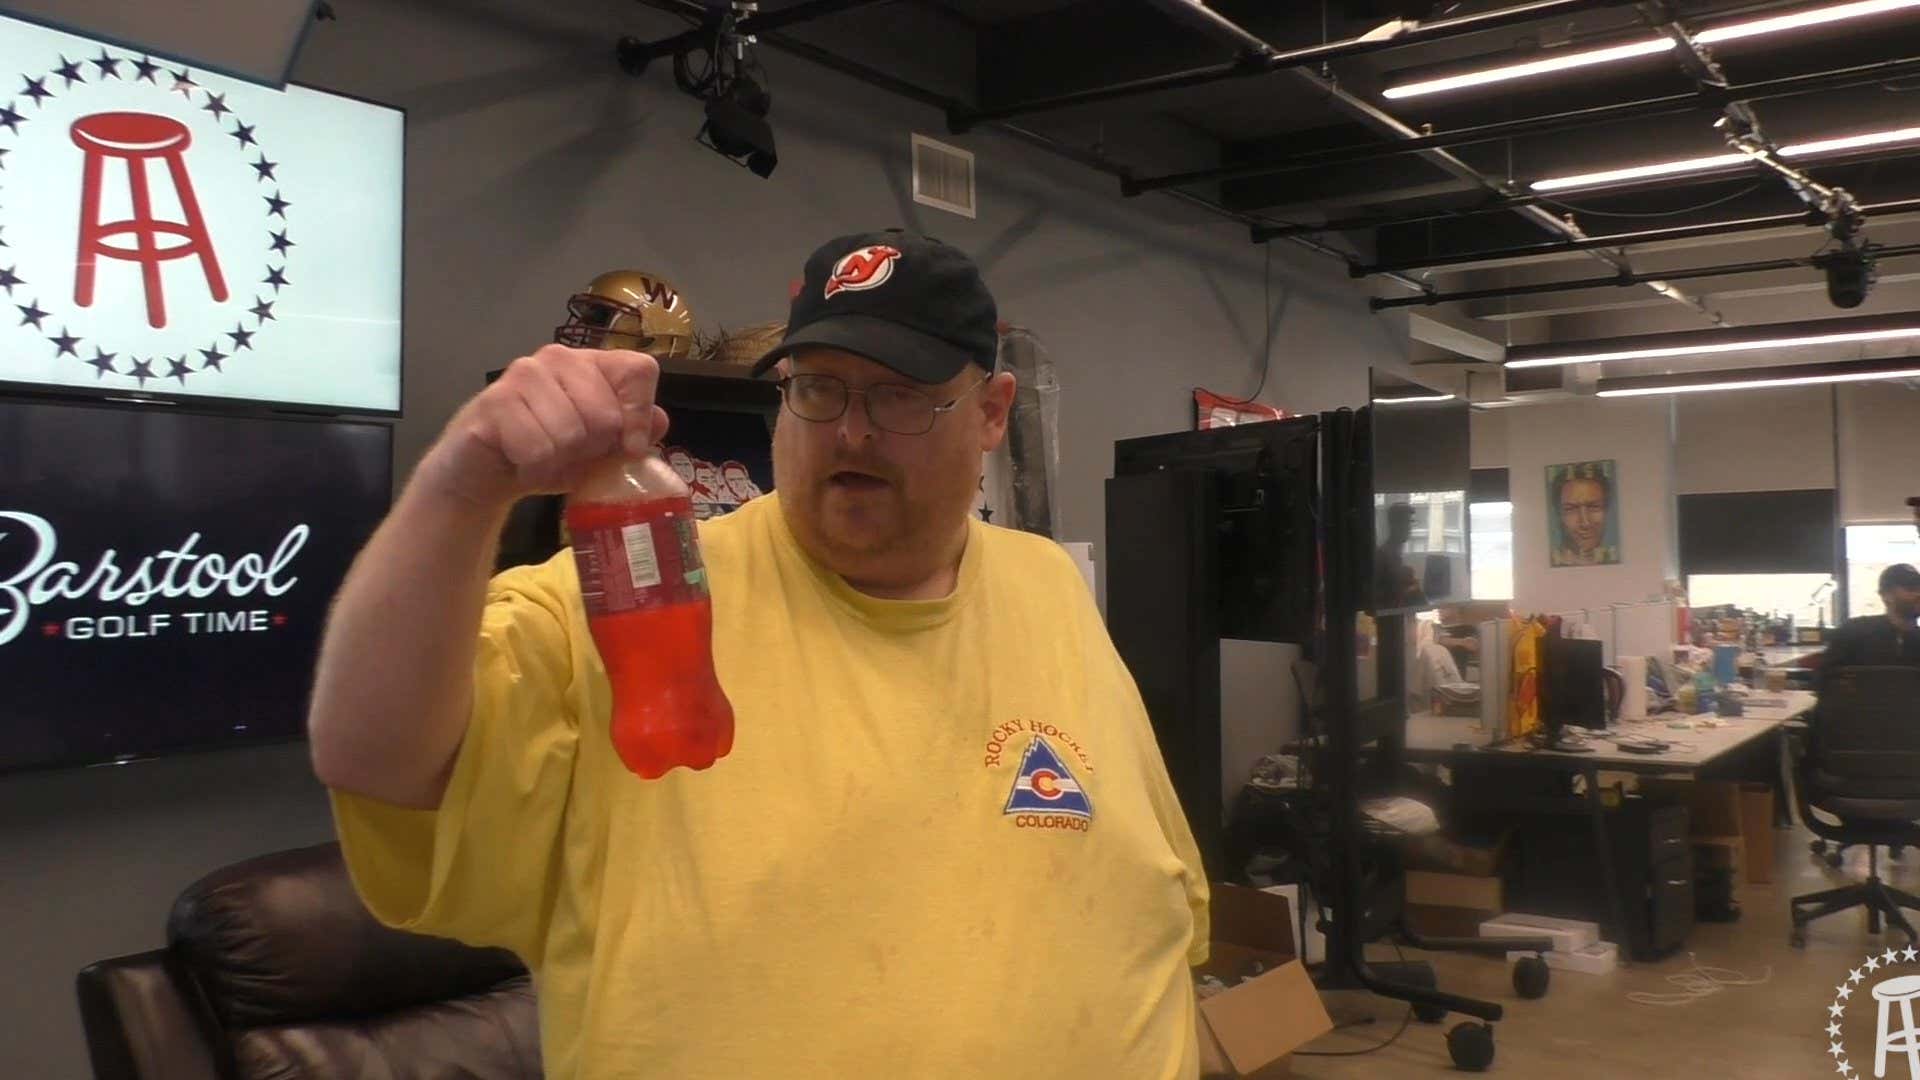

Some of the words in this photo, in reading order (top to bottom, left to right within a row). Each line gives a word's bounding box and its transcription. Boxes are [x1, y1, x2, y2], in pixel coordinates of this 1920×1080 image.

[640, 276, 678, 310] W
[66, 614, 171, 639] GOLF
[182, 610, 269, 634] TIME
[985, 719, 1024, 768] ROCKY
[1031, 769, 1063, 799] C
[1015, 815, 1089, 832] COLORADO
